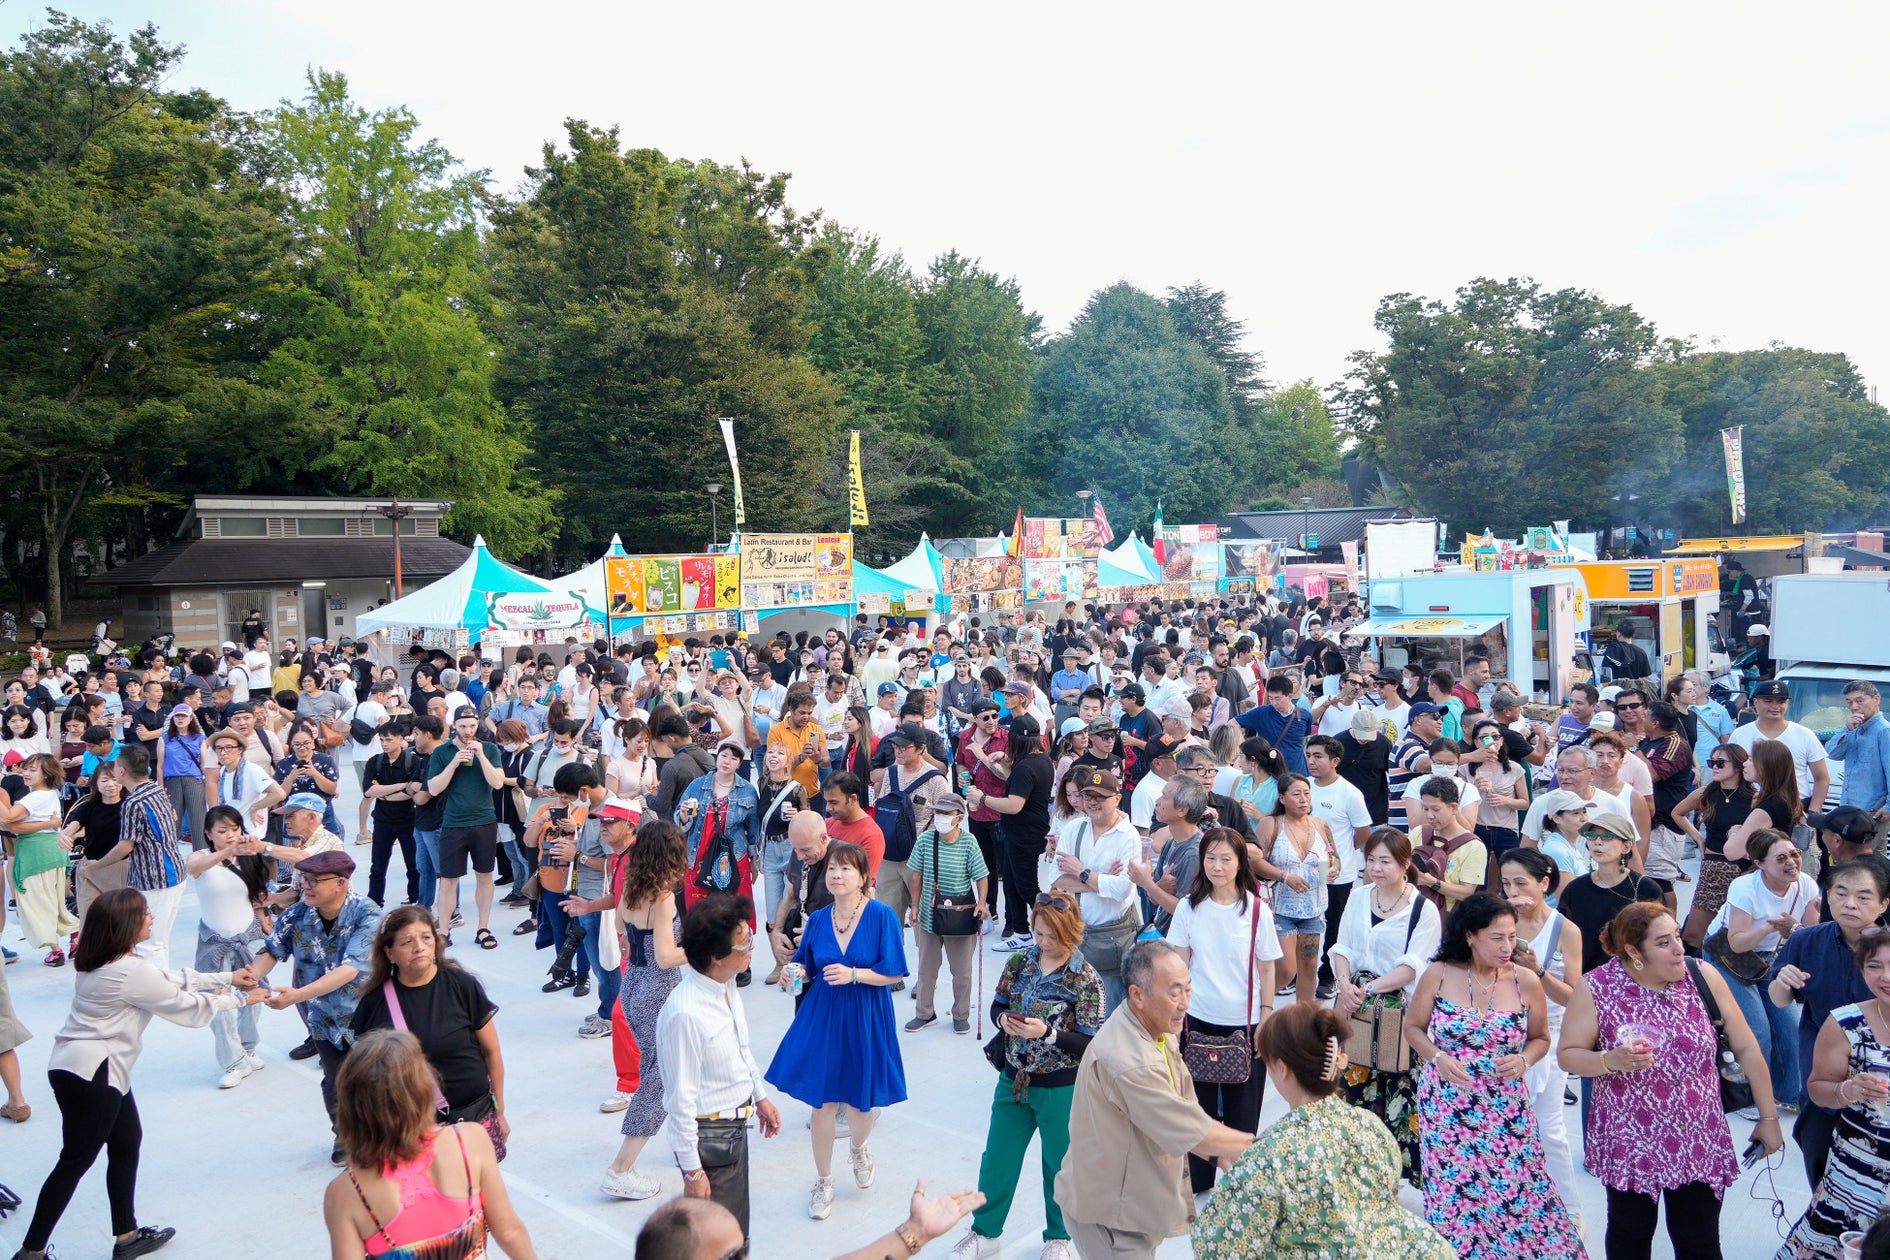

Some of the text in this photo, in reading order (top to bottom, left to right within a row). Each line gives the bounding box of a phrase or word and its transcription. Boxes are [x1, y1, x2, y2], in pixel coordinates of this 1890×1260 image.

[761, 538, 795, 546] Restaurant
[659, 565, 679, 604] ピスコ
[500, 602, 580, 613] MEZCAL TEQUILA
